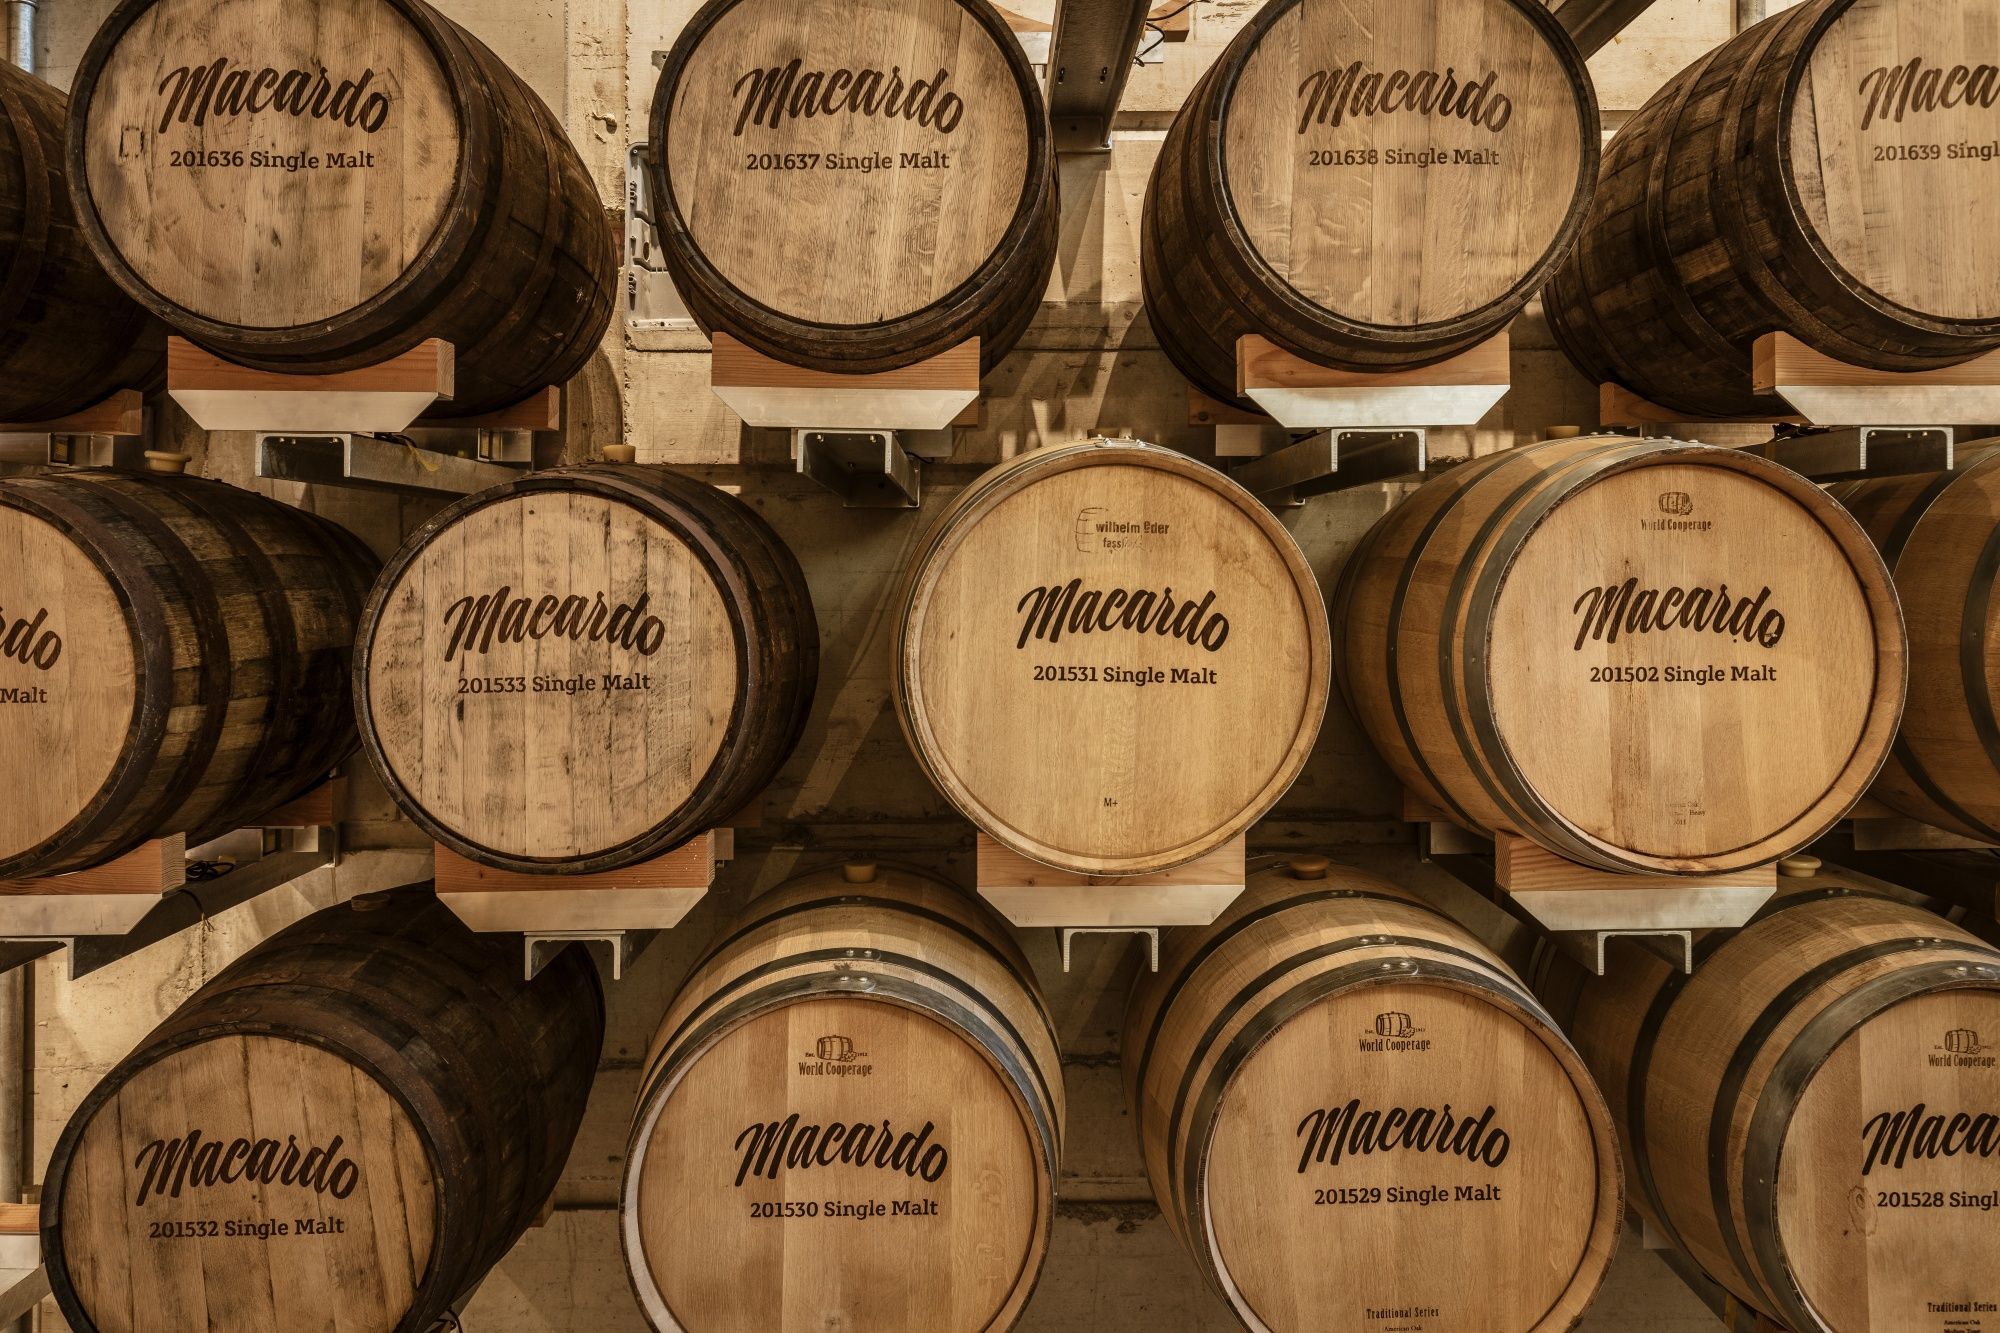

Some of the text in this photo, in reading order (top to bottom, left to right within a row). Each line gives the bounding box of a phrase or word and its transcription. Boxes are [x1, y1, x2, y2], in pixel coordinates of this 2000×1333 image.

[158, 57, 389, 134] Macardo
[732, 58, 964, 137] Macardo
[1298, 60, 1512, 135] Macardo
[1858, 56, 2000, 131] Maca
[170, 149, 375, 173] 201636 Single Malt
[746, 151, 950, 174] 201637 Single Malt
[1309, 147, 1500, 169] 201638 Single Malt
[1873, 140, 2000, 162] 201639 Singl
[1095, 521, 1140, 534] wilhelm
[1667, 519, 1712, 532] Cooperage
[443, 585, 666, 663] Macardo
[1016, 577, 1230, 652] Macardo
[1573, 576, 1786, 651] Macardo
[458, 673, 651, 695] 201533 Single Malt
[1033, 665, 1218, 687] 201531 Single Malt
[1589, 664, 1777, 686] 201502 Single Malt
[0, 686, 48, 704] Malt
[1359, 1038, 1431, 1053] World Cooperage
[798, 1061, 873, 1078] World Cooperage
[1928, 1054, 1996, 1069] World Cooperage
[1296, 1098, 1511, 1174] Macardo
[1861, 1103, 2000, 1176] Maca
[734, 1112, 948, 1187] Macardo
[134, 1129, 359, 1207] Macardo
[1314, 1183, 1501, 1207] 201529 Single Malt
[1877, 1190, 2000, 1211] 201528 Singl
[750, 1198, 938, 1221] 201530 Single Malt
[149, 1216, 345, 1240] 201532 Single Malt
[1366, 1306, 1439, 1319] Traditional Series
[1927, 1301, 1997, 1312] Traditional Series
